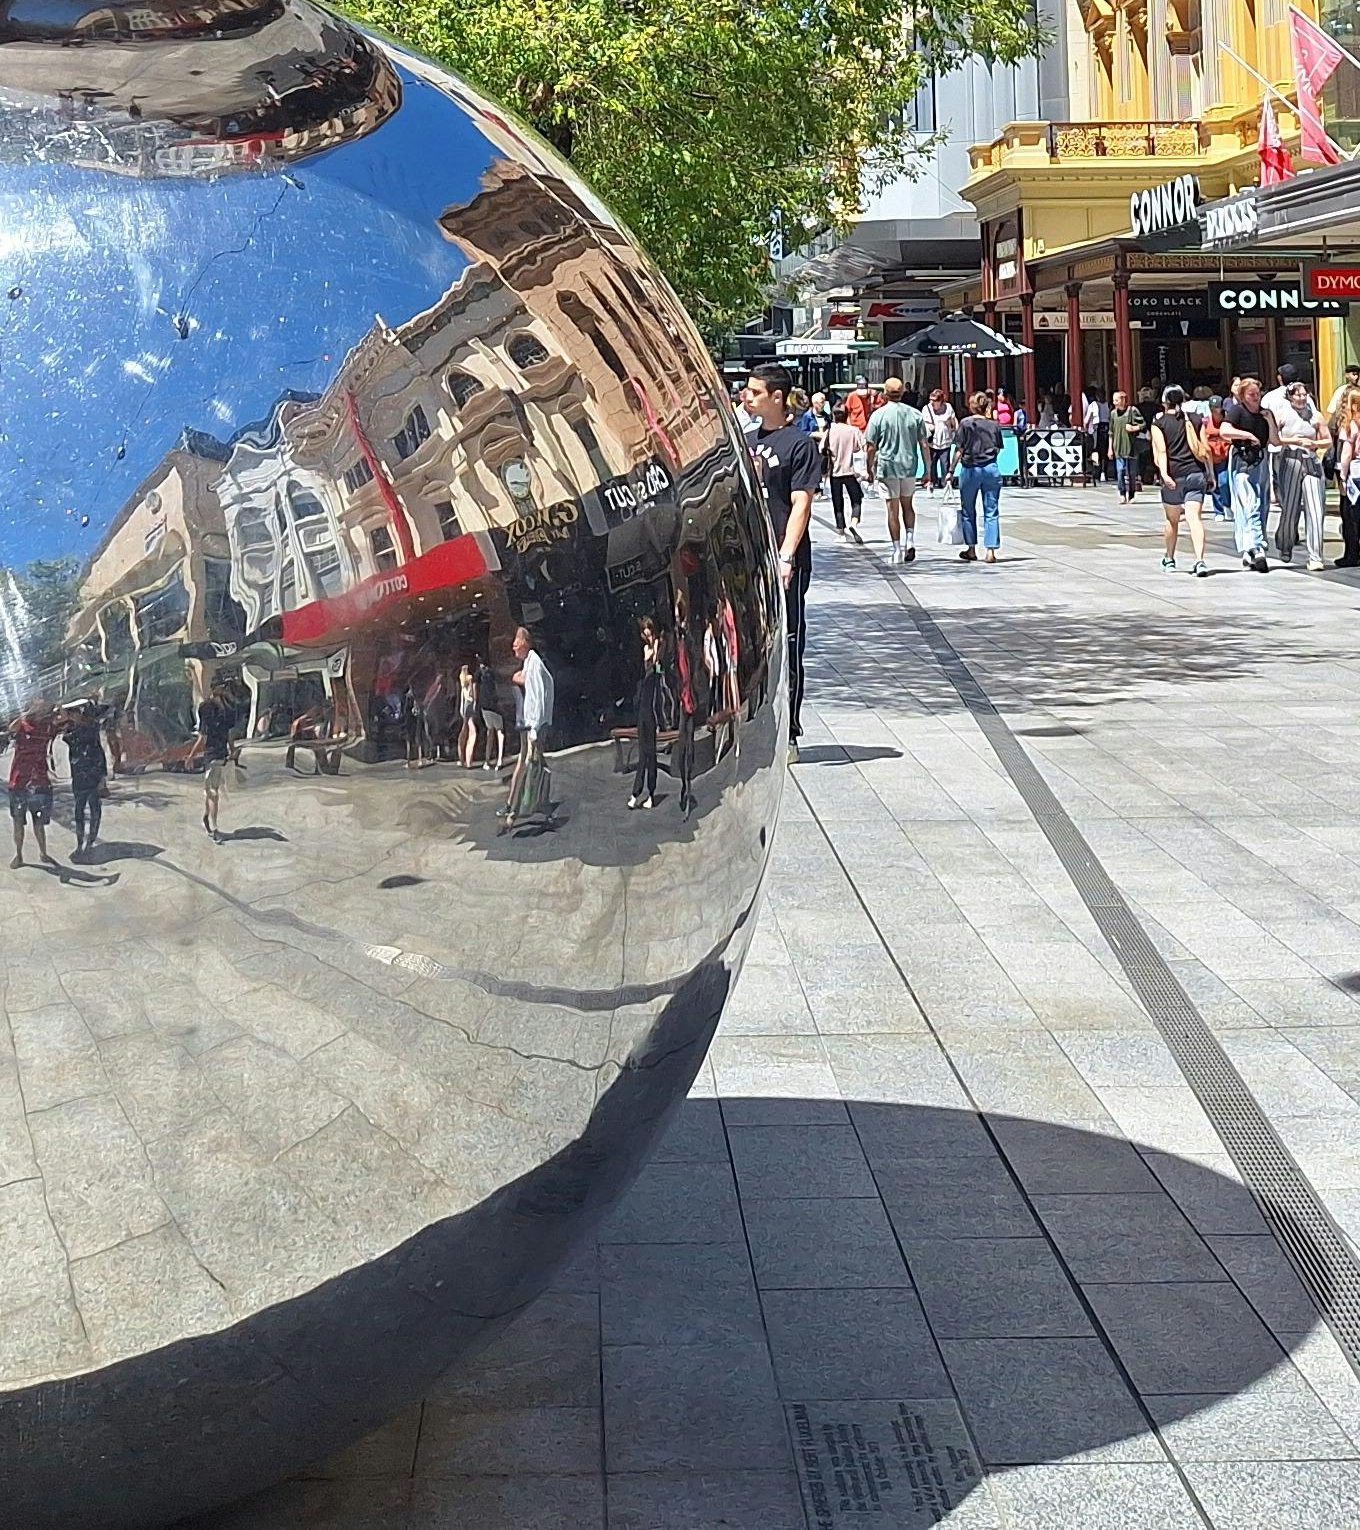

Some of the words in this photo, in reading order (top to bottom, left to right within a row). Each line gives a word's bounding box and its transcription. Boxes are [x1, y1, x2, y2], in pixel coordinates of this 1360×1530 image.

[1130, 173, 1197, 235] CONNOR
[1163, 297, 1202, 306] BLACK
[1218, 289, 1341, 310] CONN
